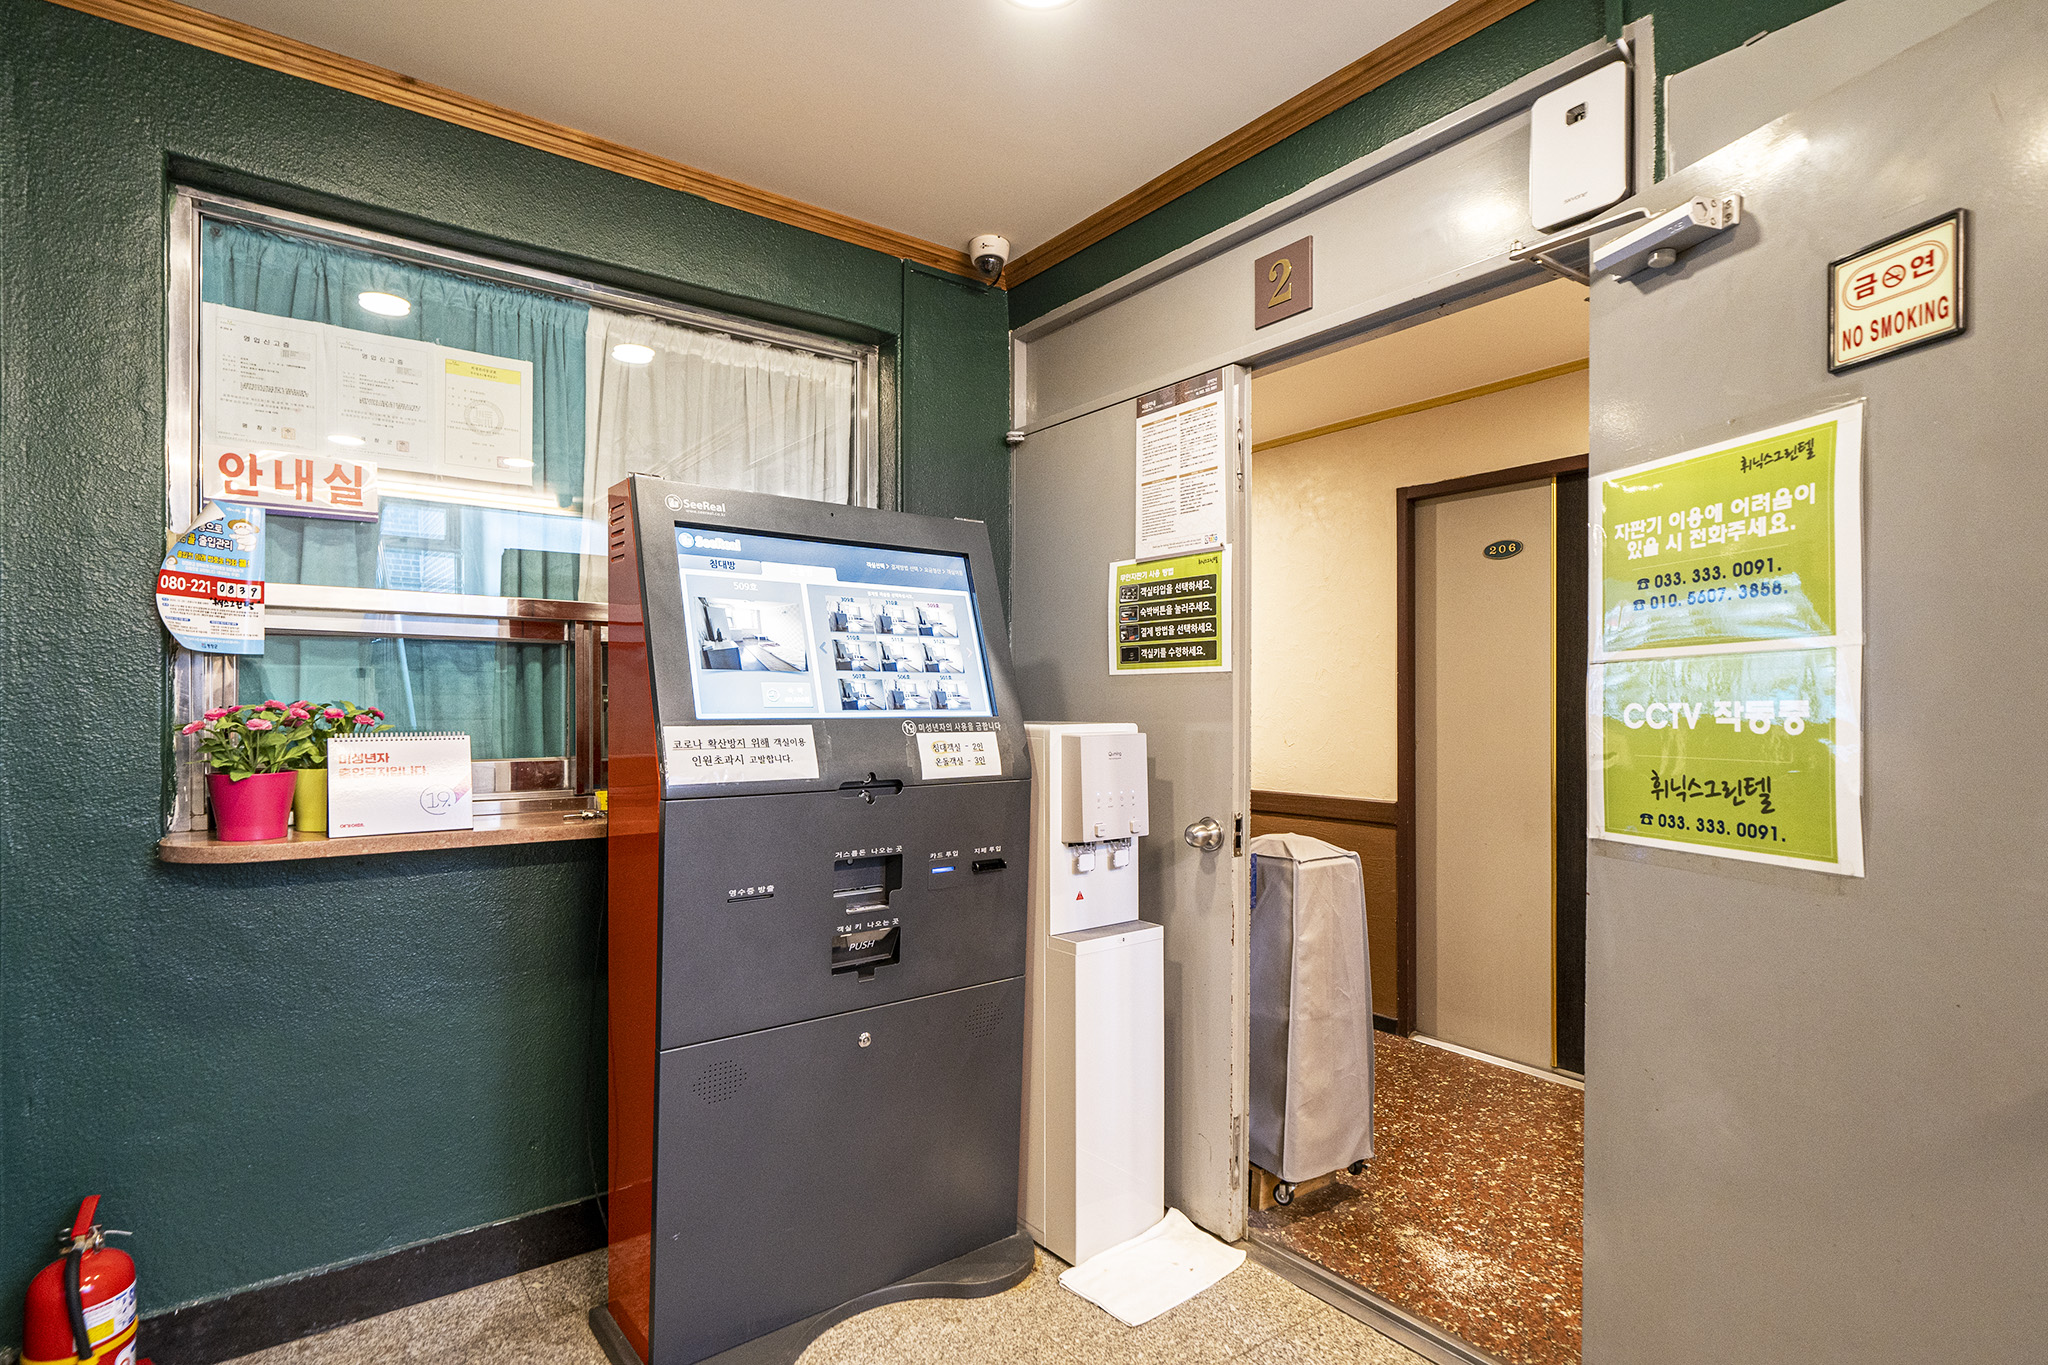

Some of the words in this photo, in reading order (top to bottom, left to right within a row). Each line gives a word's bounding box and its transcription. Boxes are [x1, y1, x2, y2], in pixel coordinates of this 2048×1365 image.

[1854, 272, 1877, 300] 금
[1911, 249, 1934, 279] 연
[1268, 258, 1292, 308] 2
[1842, 325, 1863, 351] NO
[1870, 296, 1949, 341] SMOKING
[1740, 438, 1816, 473] 휘닉스그린텔
[218, 452, 363, 506] 안내실
[683, 499, 726, 512] SeeReal
[1614, 516, 1662, 541] 자판기
[1668, 503, 1723, 530] 이용에
[1730, 482, 1816, 517] 어려움이
[198, 534, 233, 552] 출입관리
[694, 535, 742, 552] SeeReal
[1627, 537, 1659, 560] 있을
[1665, 532, 1682, 552] 시
[1690, 512, 1796, 549] 전화주세요.
[1489, 543, 1516, 555] 206
[710, 559, 736, 570] 침대방
[1654, 568, 1687, 588] 033.
[1692, 565, 1726, 583] 333.
[1732, 557, 1782, 578] 0091.
[1120, 571, 1148, 582] 무인자판기
[1149, 569, 1160, 578] 사용
[1162, 567, 1174, 576] 방법
[160, 575, 259, 598] 080-221-0839
[733, 582, 759, 591] 509호
[1140, 583, 1173, 597] 객실타입을
[1174, 579, 1213, 593] 선택하세요.
[1650, 595, 1682, 609] 010.
[1687, 587, 1732, 605] 5607.
[1738, 581, 1788, 600] 3858.
[1140, 604, 1173, 617] 숙박버튼을
[1174, 601, 1213, 615] 눌러주세요.
[1141, 627, 1154, 638] 결제
[1155, 625, 1175, 637] 방법을
[1177, 622, 1215, 635] 선택하세요.
[1141, 647, 1167, 658] 객실키를
[1168, 645, 1206, 658] 수령하세요.
[1623, 702, 1702, 729] CCTV
[918, 722, 953, 732] 미성년자의
[954, 722, 974, 731] 사용을
[975, 721, 1001, 731] 금합니다
[673, 739, 703, 749] 코로나
[707, 738, 746, 749] 확산방지
[751, 737, 770, 748] 위해
[773, 737, 807, 748] 객실이용
[338, 752, 390, 764] 미성년자
[692, 754, 745, 767] 인원초과시
[749, 754, 794, 765] 고발합니다.
[974, 756, 986, 765] 3인
[1650, 769, 1775, 814] 휘닉스그린텔
[1657, 814, 1690, 831] 033.
[1696, 818, 1731, 836] 333.
[1736, 822, 1786, 842] 0091.
[871, 846, 893, 855] 나오는
[728, 886, 755, 897] 영수증
[836, 924, 852, 932] 객실
[854, 923, 862, 931] 키
[866, 919, 890, 928] 나오는
[892, 917, 900, 925] 곳
[849, 939, 875, 951] PUSH
